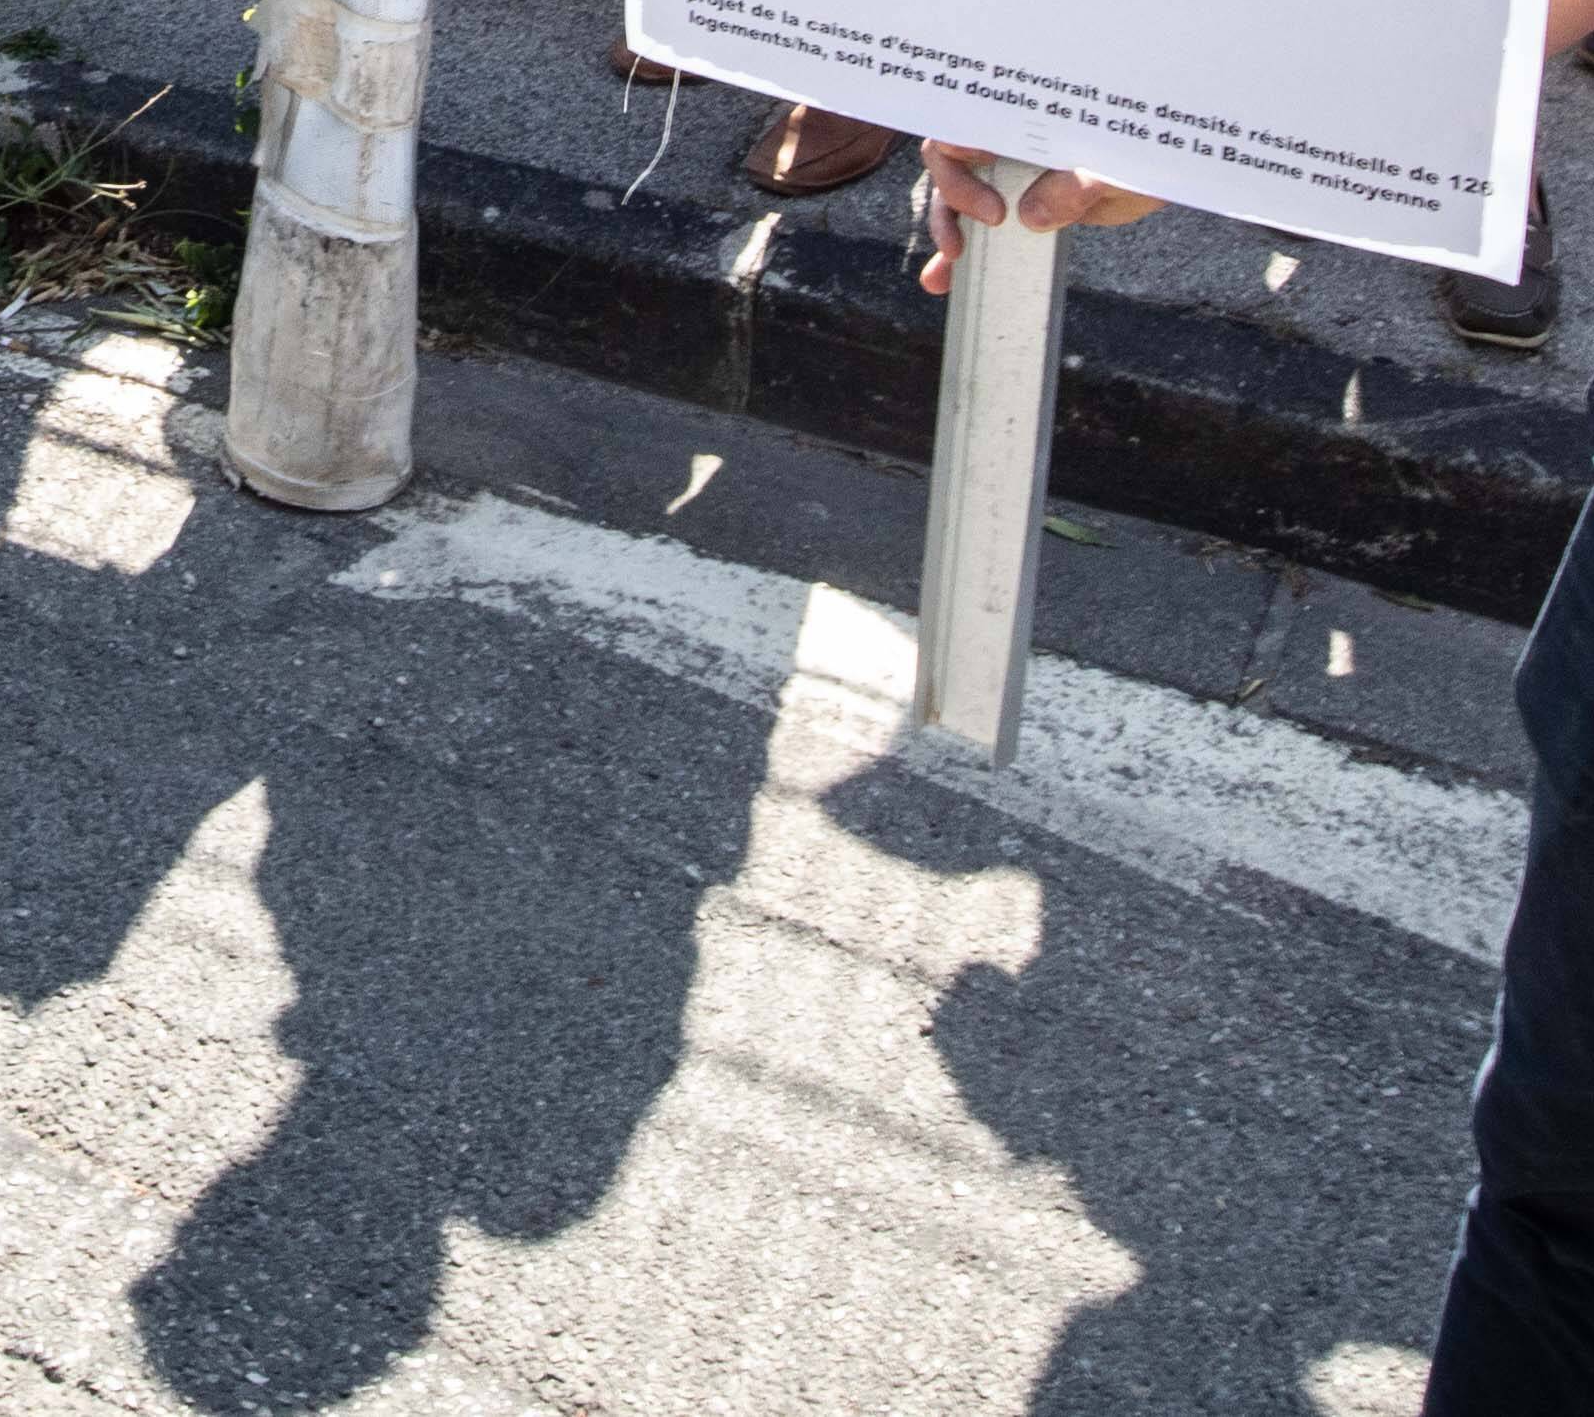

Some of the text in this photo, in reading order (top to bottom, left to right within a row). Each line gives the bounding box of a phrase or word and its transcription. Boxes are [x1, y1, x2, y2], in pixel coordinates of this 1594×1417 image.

[689, 10, 1441, 211] logements/ha, soit près du double de la cité de la Baume mitoyenne
[751, 4, 775, 20] de
[782, 11, 799, 26] la
[806, 21, 873, 44] caisse
[880, 36, 986, 71] d'épargne
[993, 65, 1099, 101] prévoirait
[1106, 94, 1148, 113] une
[1155, 104, 1242, 137] densité
[1249, 130, 1401, 176] résidentielle
[1409, 167, 1439, 185] de
